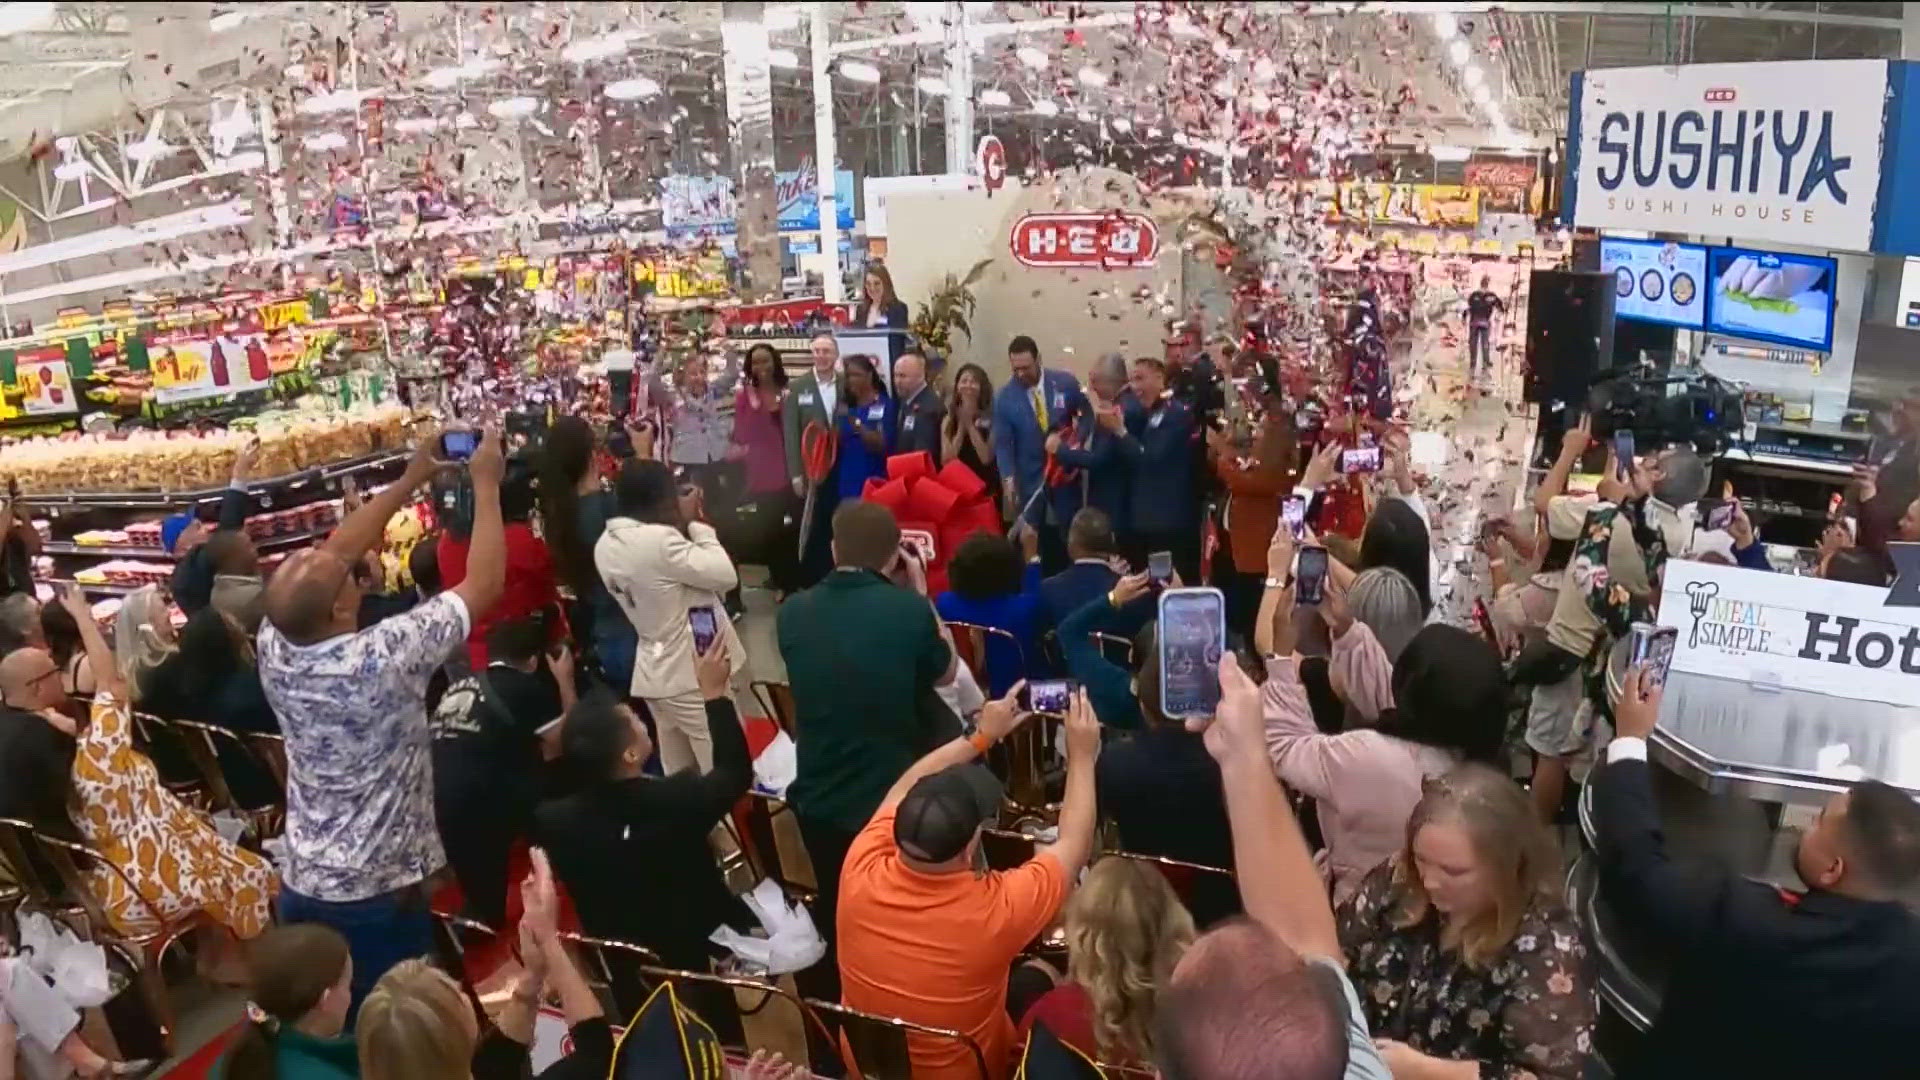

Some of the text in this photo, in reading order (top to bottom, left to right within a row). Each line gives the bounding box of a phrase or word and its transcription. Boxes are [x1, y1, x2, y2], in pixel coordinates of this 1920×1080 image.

[1608, 197, 1813, 223] SUSHI HOUSE
[1699, 621, 1771, 653] SIMPLE
[1711, 596, 1920, 675] MEAL Hot
